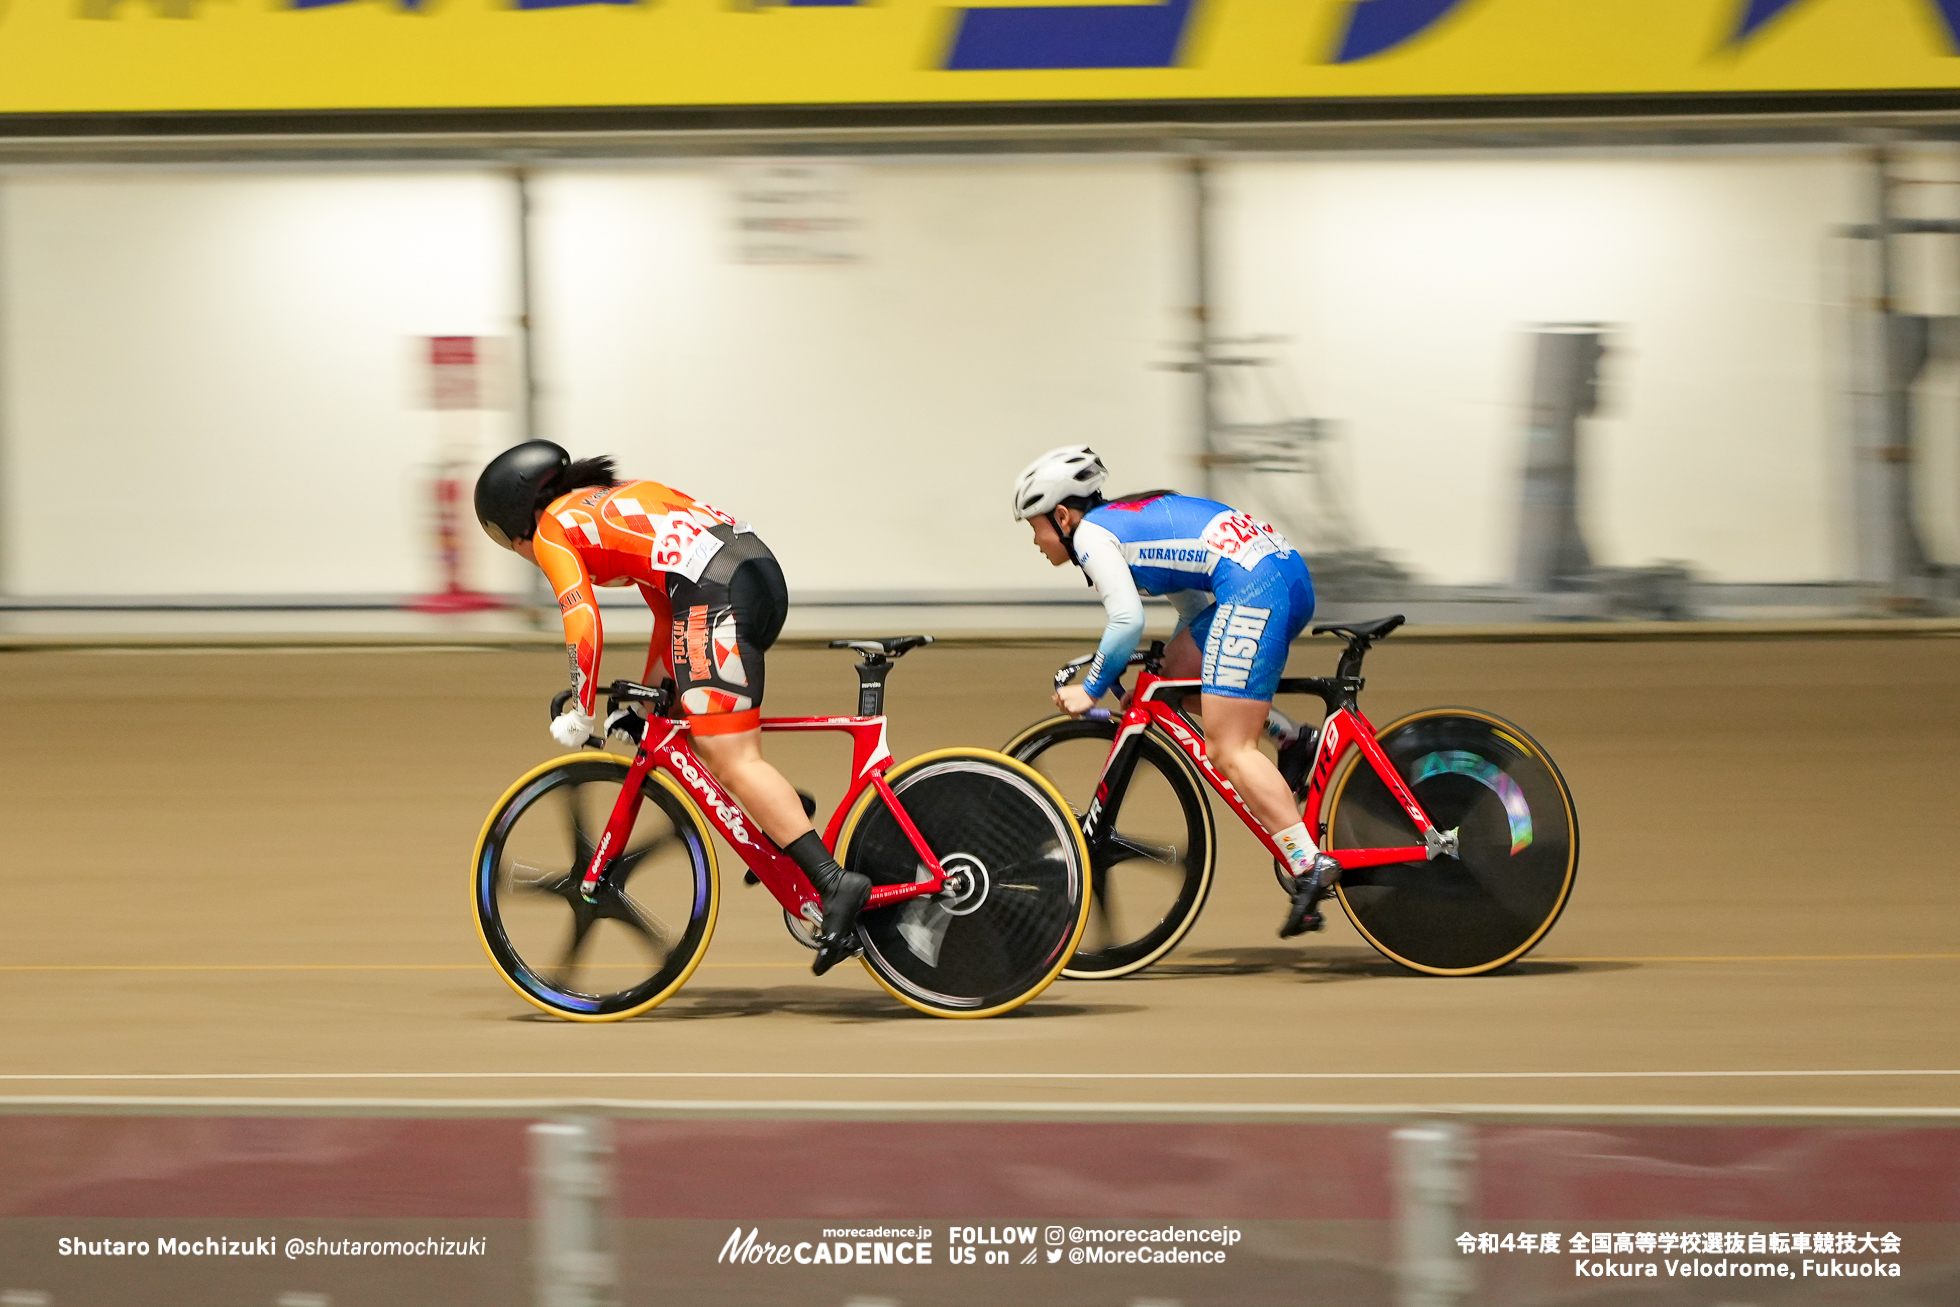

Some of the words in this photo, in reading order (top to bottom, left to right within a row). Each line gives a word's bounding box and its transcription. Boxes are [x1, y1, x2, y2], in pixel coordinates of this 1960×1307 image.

[657, 520, 702, 566] 521
[1139, 547, 1209, 564] KURAYOSHI
[673, 620, 687, 664] FUKUI
[1202, 603, 1235, 686] KURAYOSHI
[1214, 604, 1272, 690] NISHI
